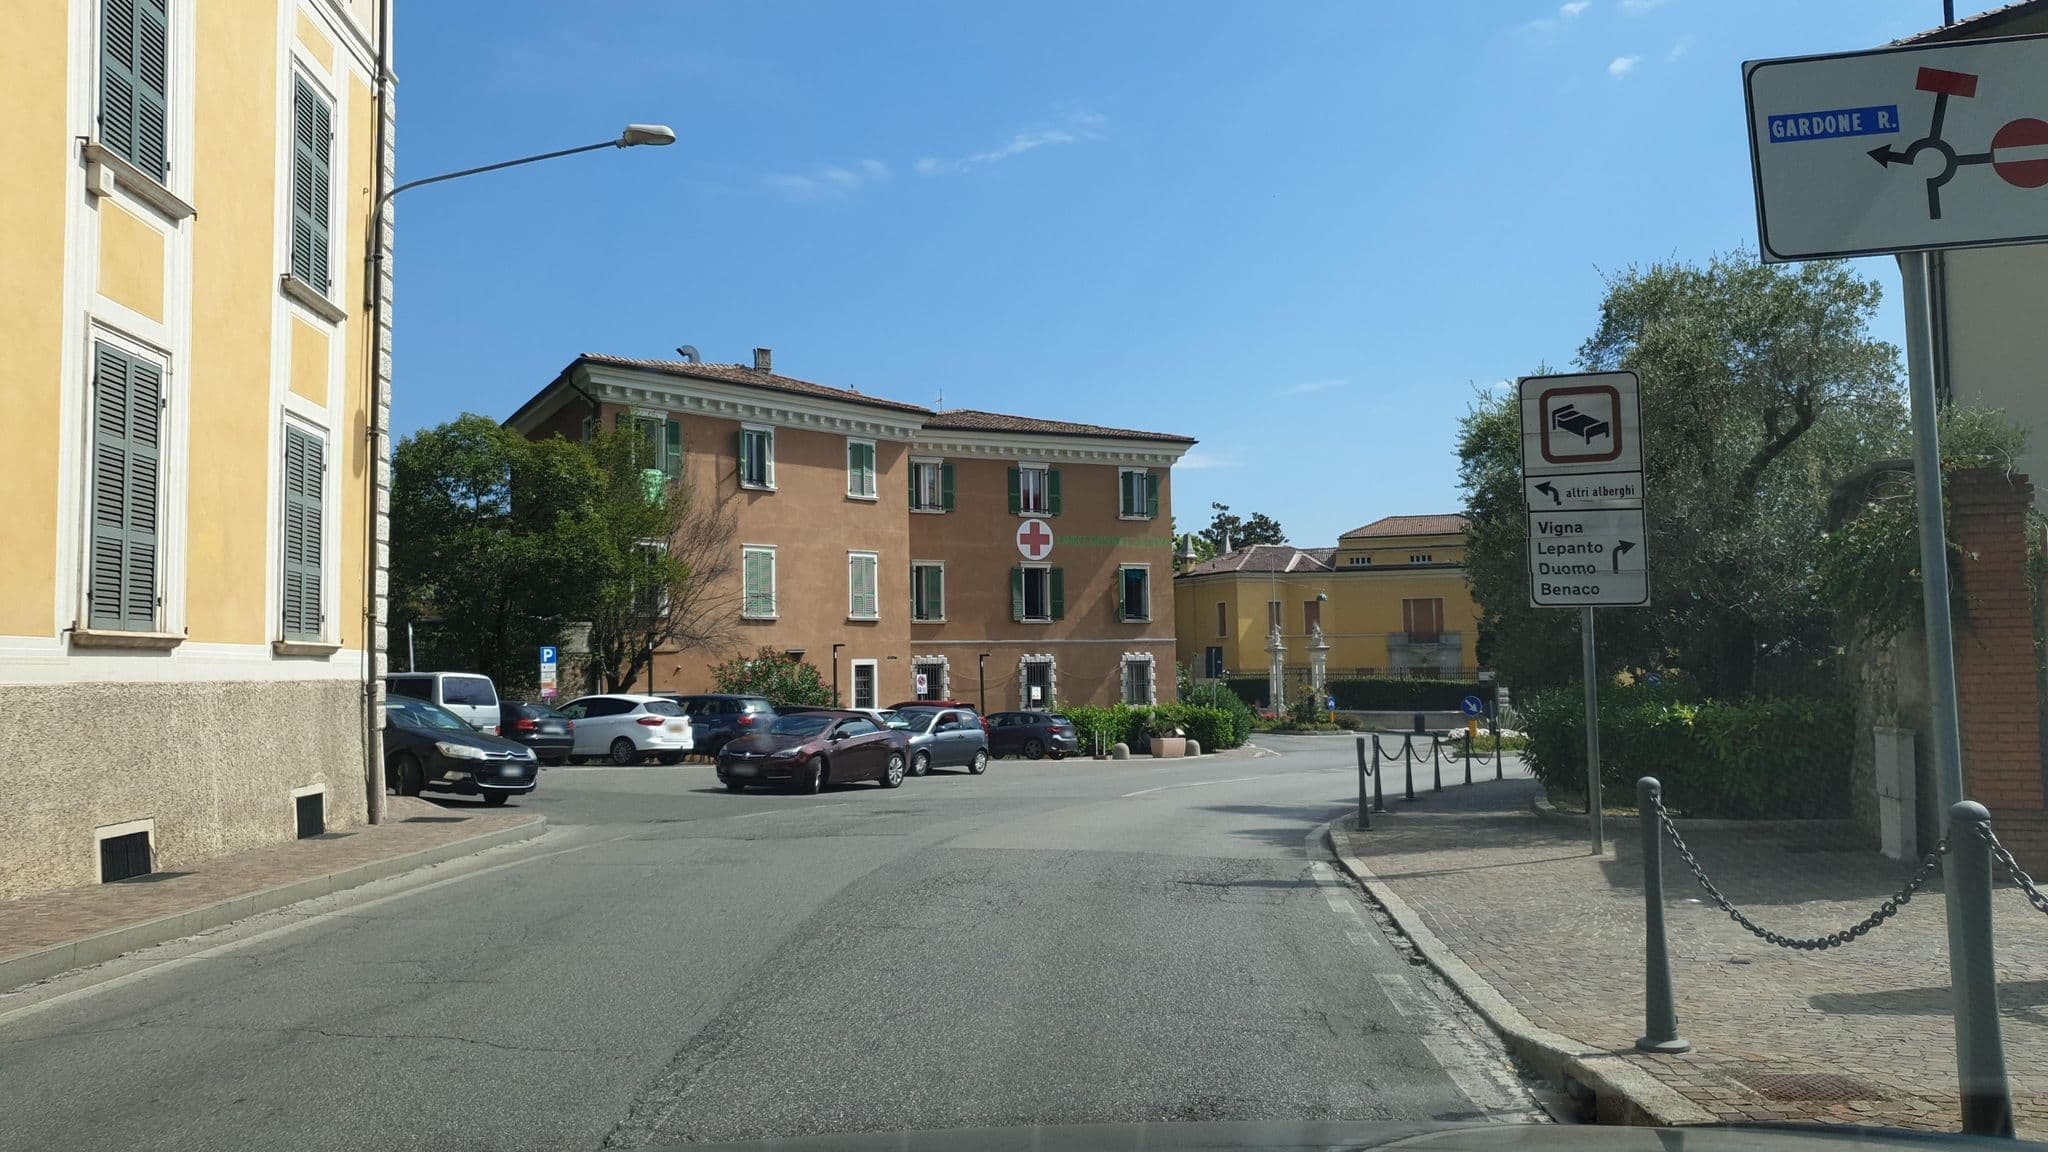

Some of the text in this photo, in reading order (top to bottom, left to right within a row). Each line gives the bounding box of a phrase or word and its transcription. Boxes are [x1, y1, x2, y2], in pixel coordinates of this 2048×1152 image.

[1772, 111, 1897, 138] GARDONE R.
[1566, 484, 1635, 498] altri alberghi
[1538, 521, 1583, 536] Vigna
[1537, 541, 1604, 557] Lepanto
[1538, 562, 1597, 575] Duomo
[1540, 582, 1600, 596] Benaco
[543, 648, 553, 663] P
